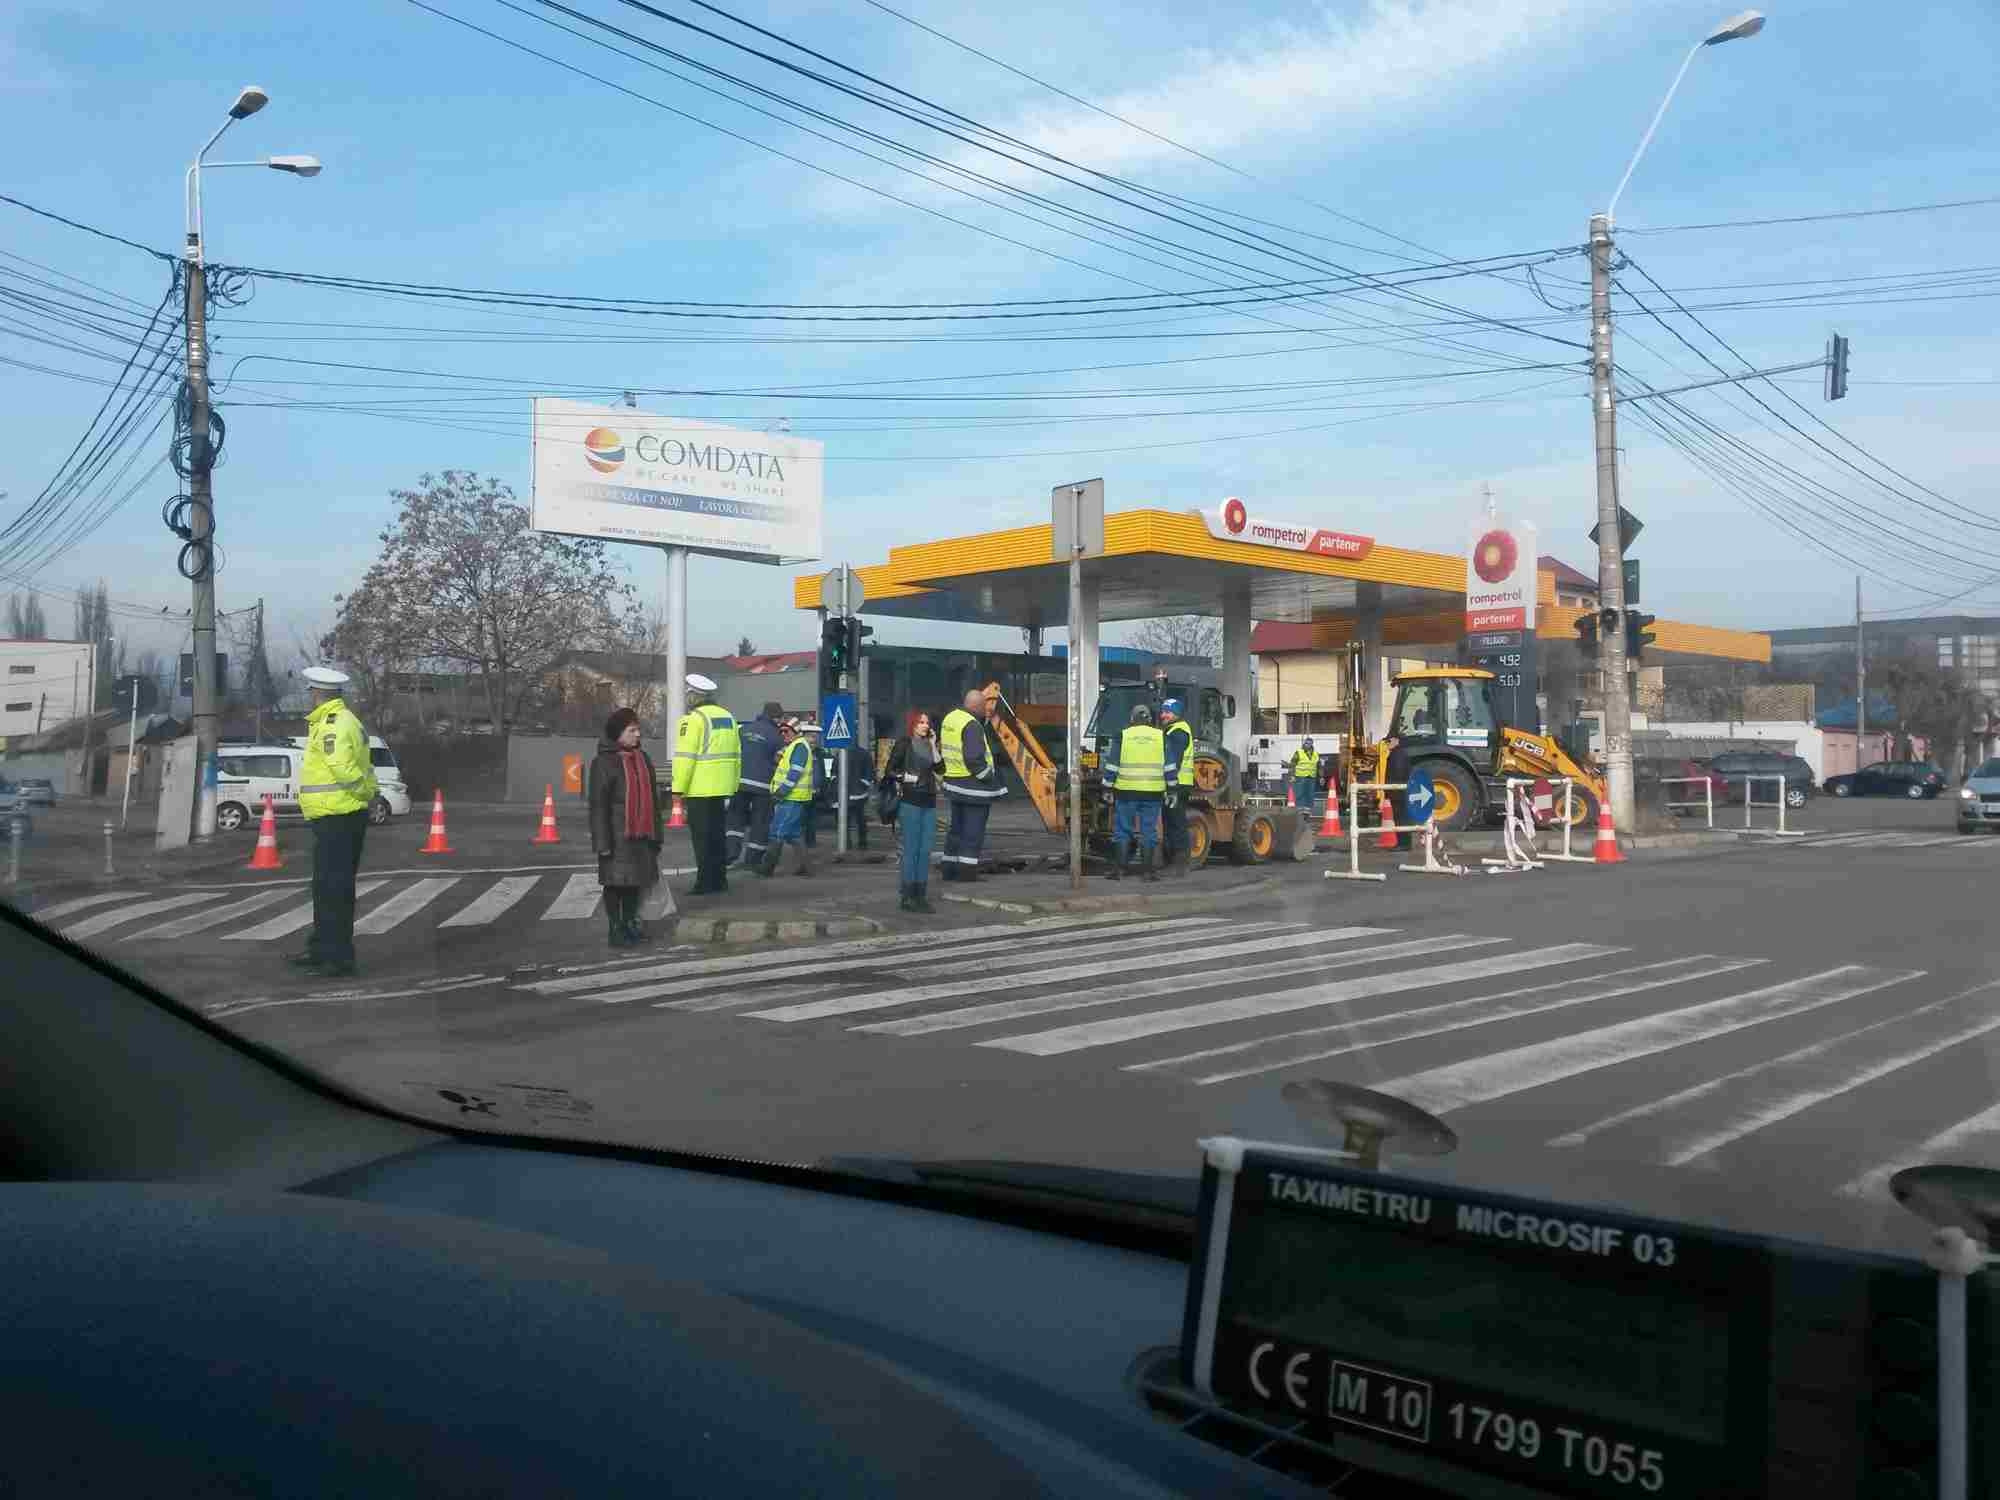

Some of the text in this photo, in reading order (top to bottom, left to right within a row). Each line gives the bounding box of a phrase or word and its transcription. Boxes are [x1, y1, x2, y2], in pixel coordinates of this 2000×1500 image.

[635, 435, 785, 482] COMDATA
[1252, 523, 1361, 552] rompetrol partener
[1470, 587, 1522, 606] rompetrol
[1473, 612, 1517, 628] partener
[1514, 738, 1545, 757] JCB
[1269, 1173, 1677, 1267] TAXIMETRU MICROSIF 03
[1336, 1372, 1368, 1415] M
[1382, 1385, 1423, 1429] 10
[1449, 1402, 1542, 1460] 1799
[1556, 1427, 1666, 1493] T055
